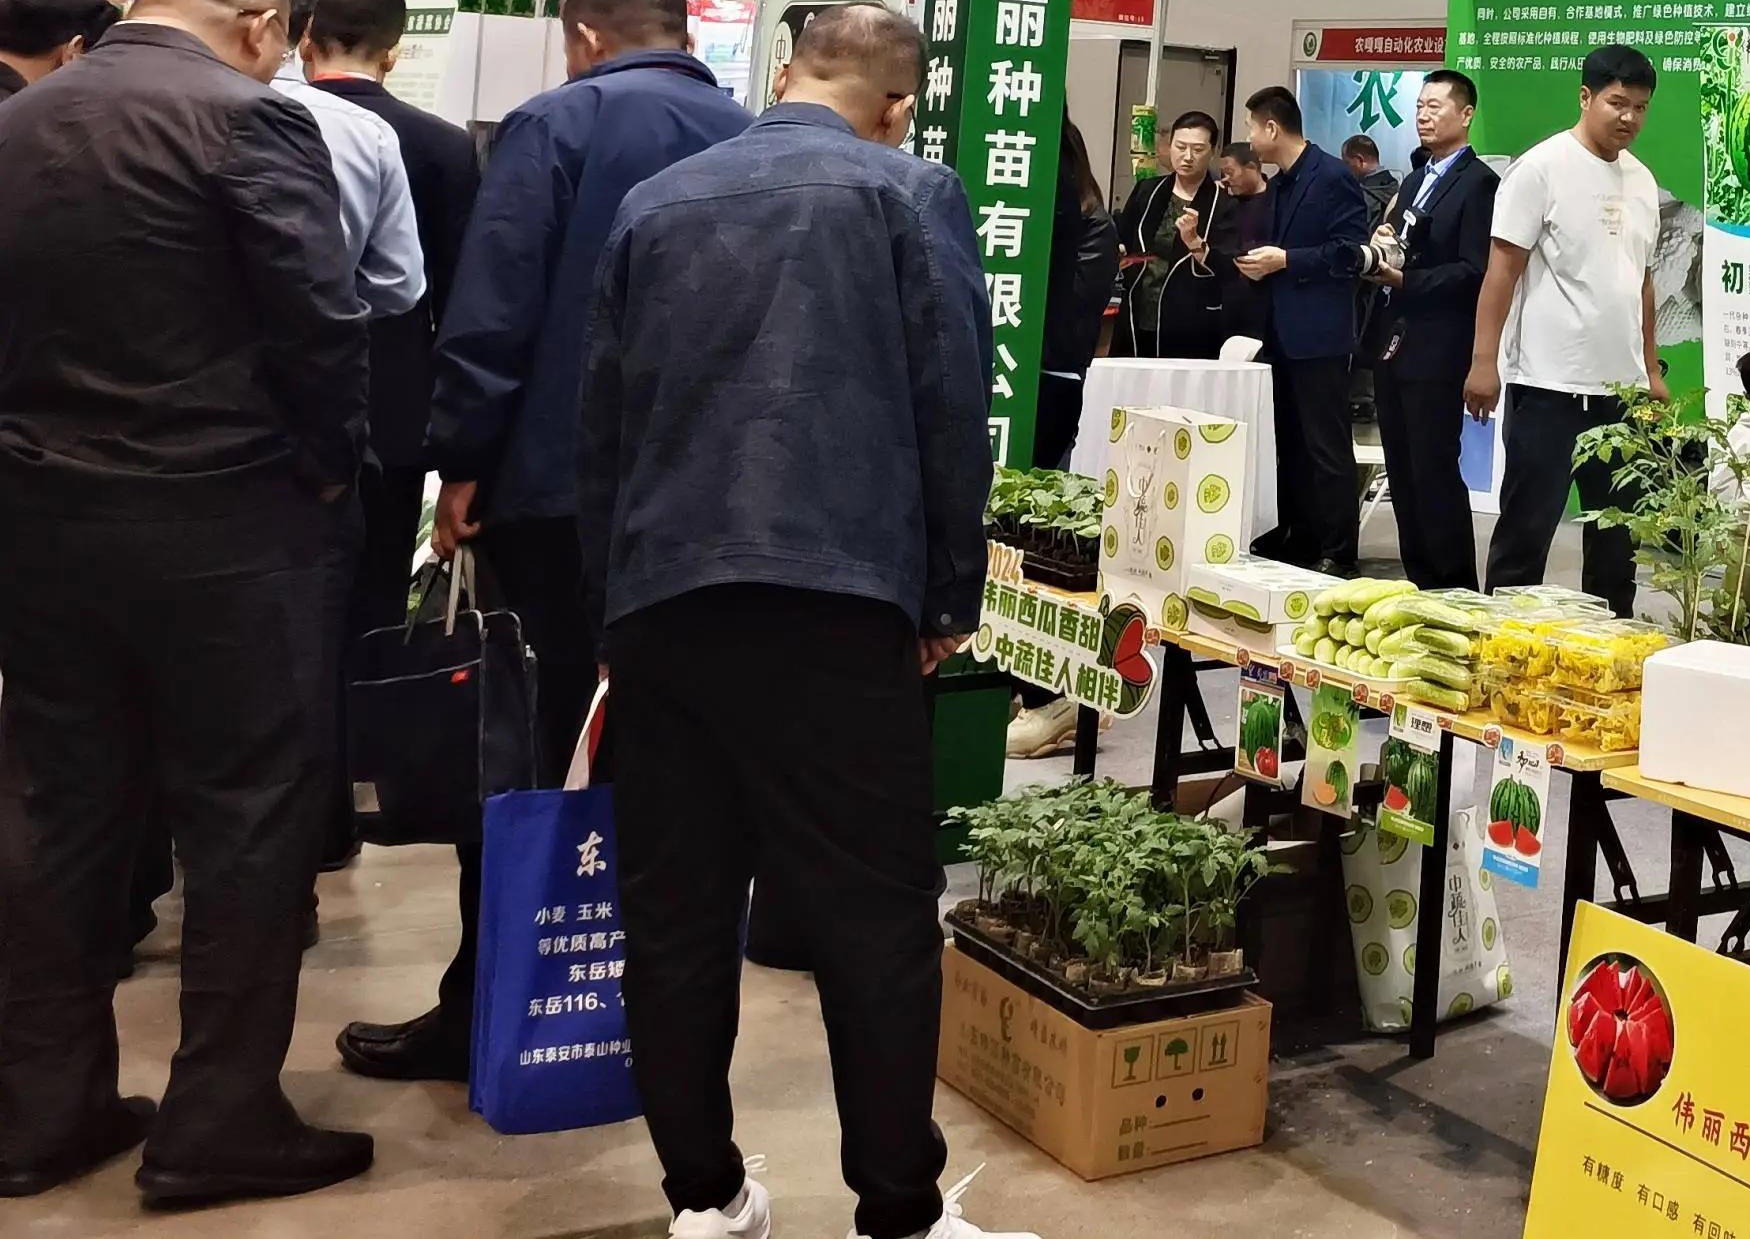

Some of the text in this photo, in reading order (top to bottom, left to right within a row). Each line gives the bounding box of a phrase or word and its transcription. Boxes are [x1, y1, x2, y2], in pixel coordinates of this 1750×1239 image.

[995, 633, 1119, 709] 中蔬佳人相伴
[576, 831, 606, 876] 东
[535, 901, 613, 925] 小麦 玉米
[538, 930, 627, 956] 等优质高产
[1582, 1154, 1625, 1193] 有糖度
[1636, 1183, 1680, 1221] 有口感
